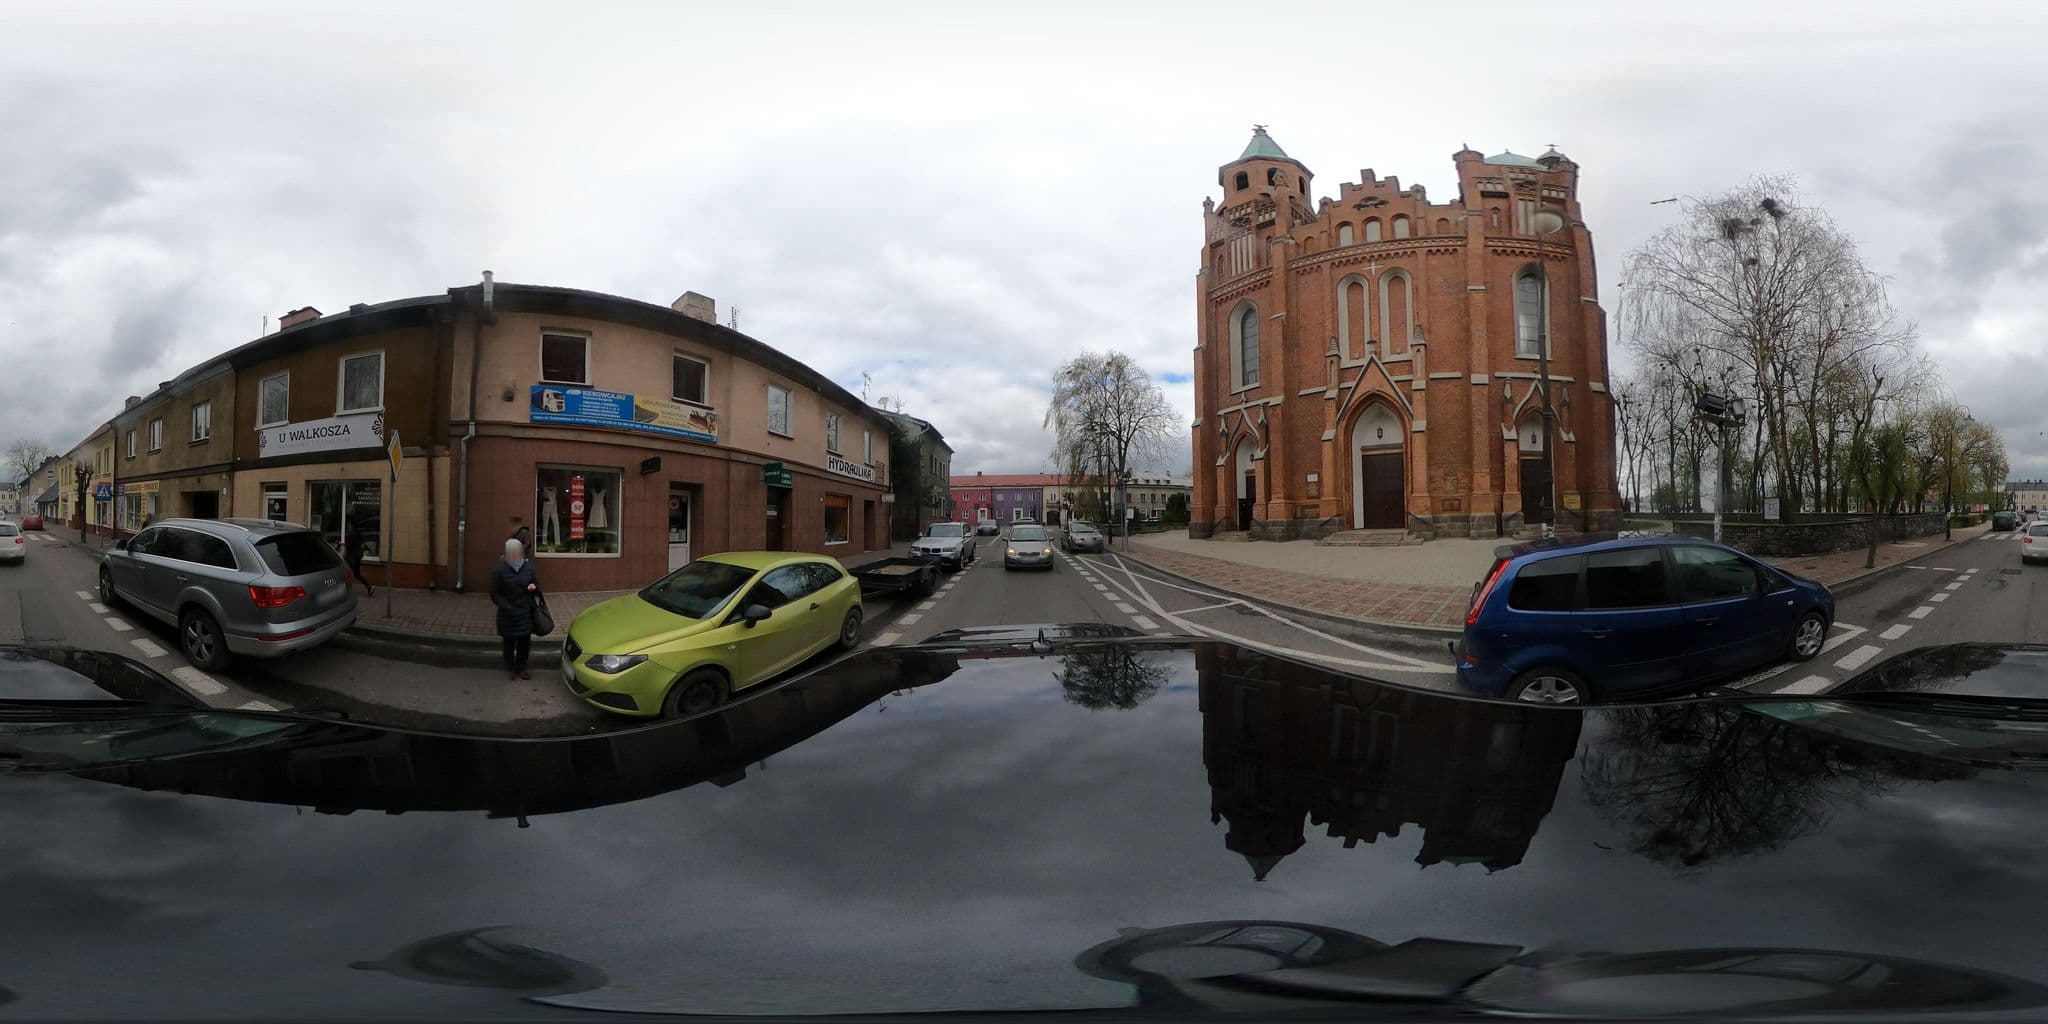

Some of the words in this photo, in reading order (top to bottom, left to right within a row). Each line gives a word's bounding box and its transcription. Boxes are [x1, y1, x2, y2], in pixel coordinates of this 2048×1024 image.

[279, 433, 286, 442] U
[289, 424, 351, 441] WALKOSZA
[828, 456, 872, 479] HYDRAULIKA
